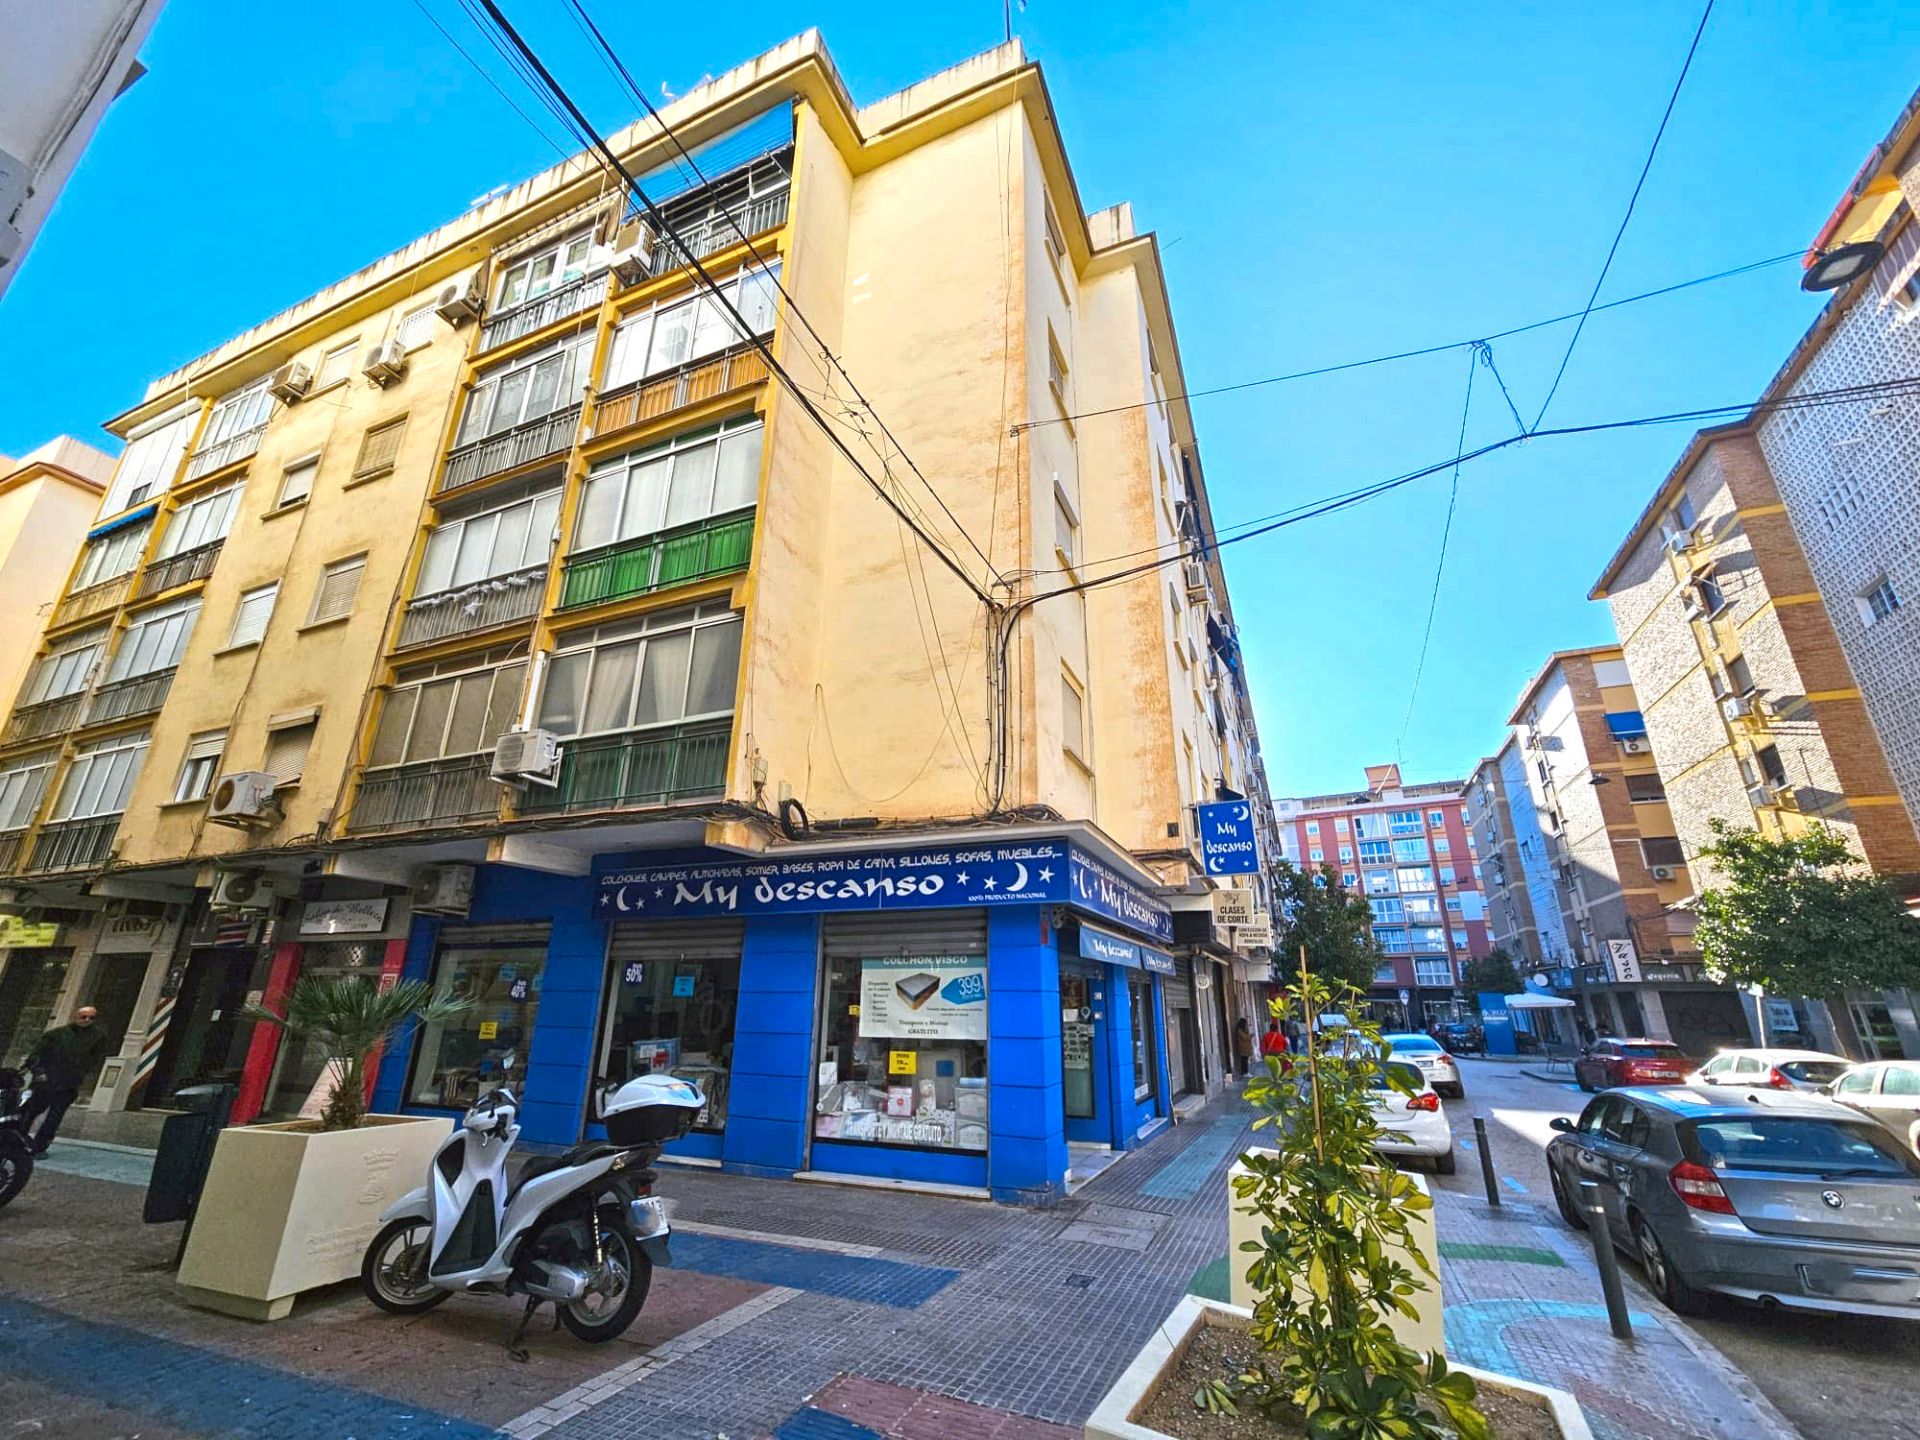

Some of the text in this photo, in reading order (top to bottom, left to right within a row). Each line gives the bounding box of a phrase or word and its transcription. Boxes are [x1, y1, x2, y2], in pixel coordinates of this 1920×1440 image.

[1216, 822, 1237, 837] My
[1206, 840, 1253, 854] descanso
[782, 862, 815, 874] BASES,
[818, 859, 844, 872] ROPA
[847, 858, 861, 870] DE
[864, 857, 896, 871] CAMA,
[899, 853, 952, 867] SILLONES,
[955, 850, 994, 864] SOFAS,
[673, 873, 945, 911] My descanso
[984, 893, 1016, 902] PRODUCTO
[1016, 891, 1047, 900] NACIONAL
[1101, 879, 1121, 918] My
[1123, 890, 1159, 929] descanso
[1220, 906, 1246, 915] CLASES
[1217, 914, 1250, 924] DE CORTE
[935, 955, 968, 965] VISCO
[1611, 942, 1634, 980] Vasco
[626, 968, 644, 982] 50%
